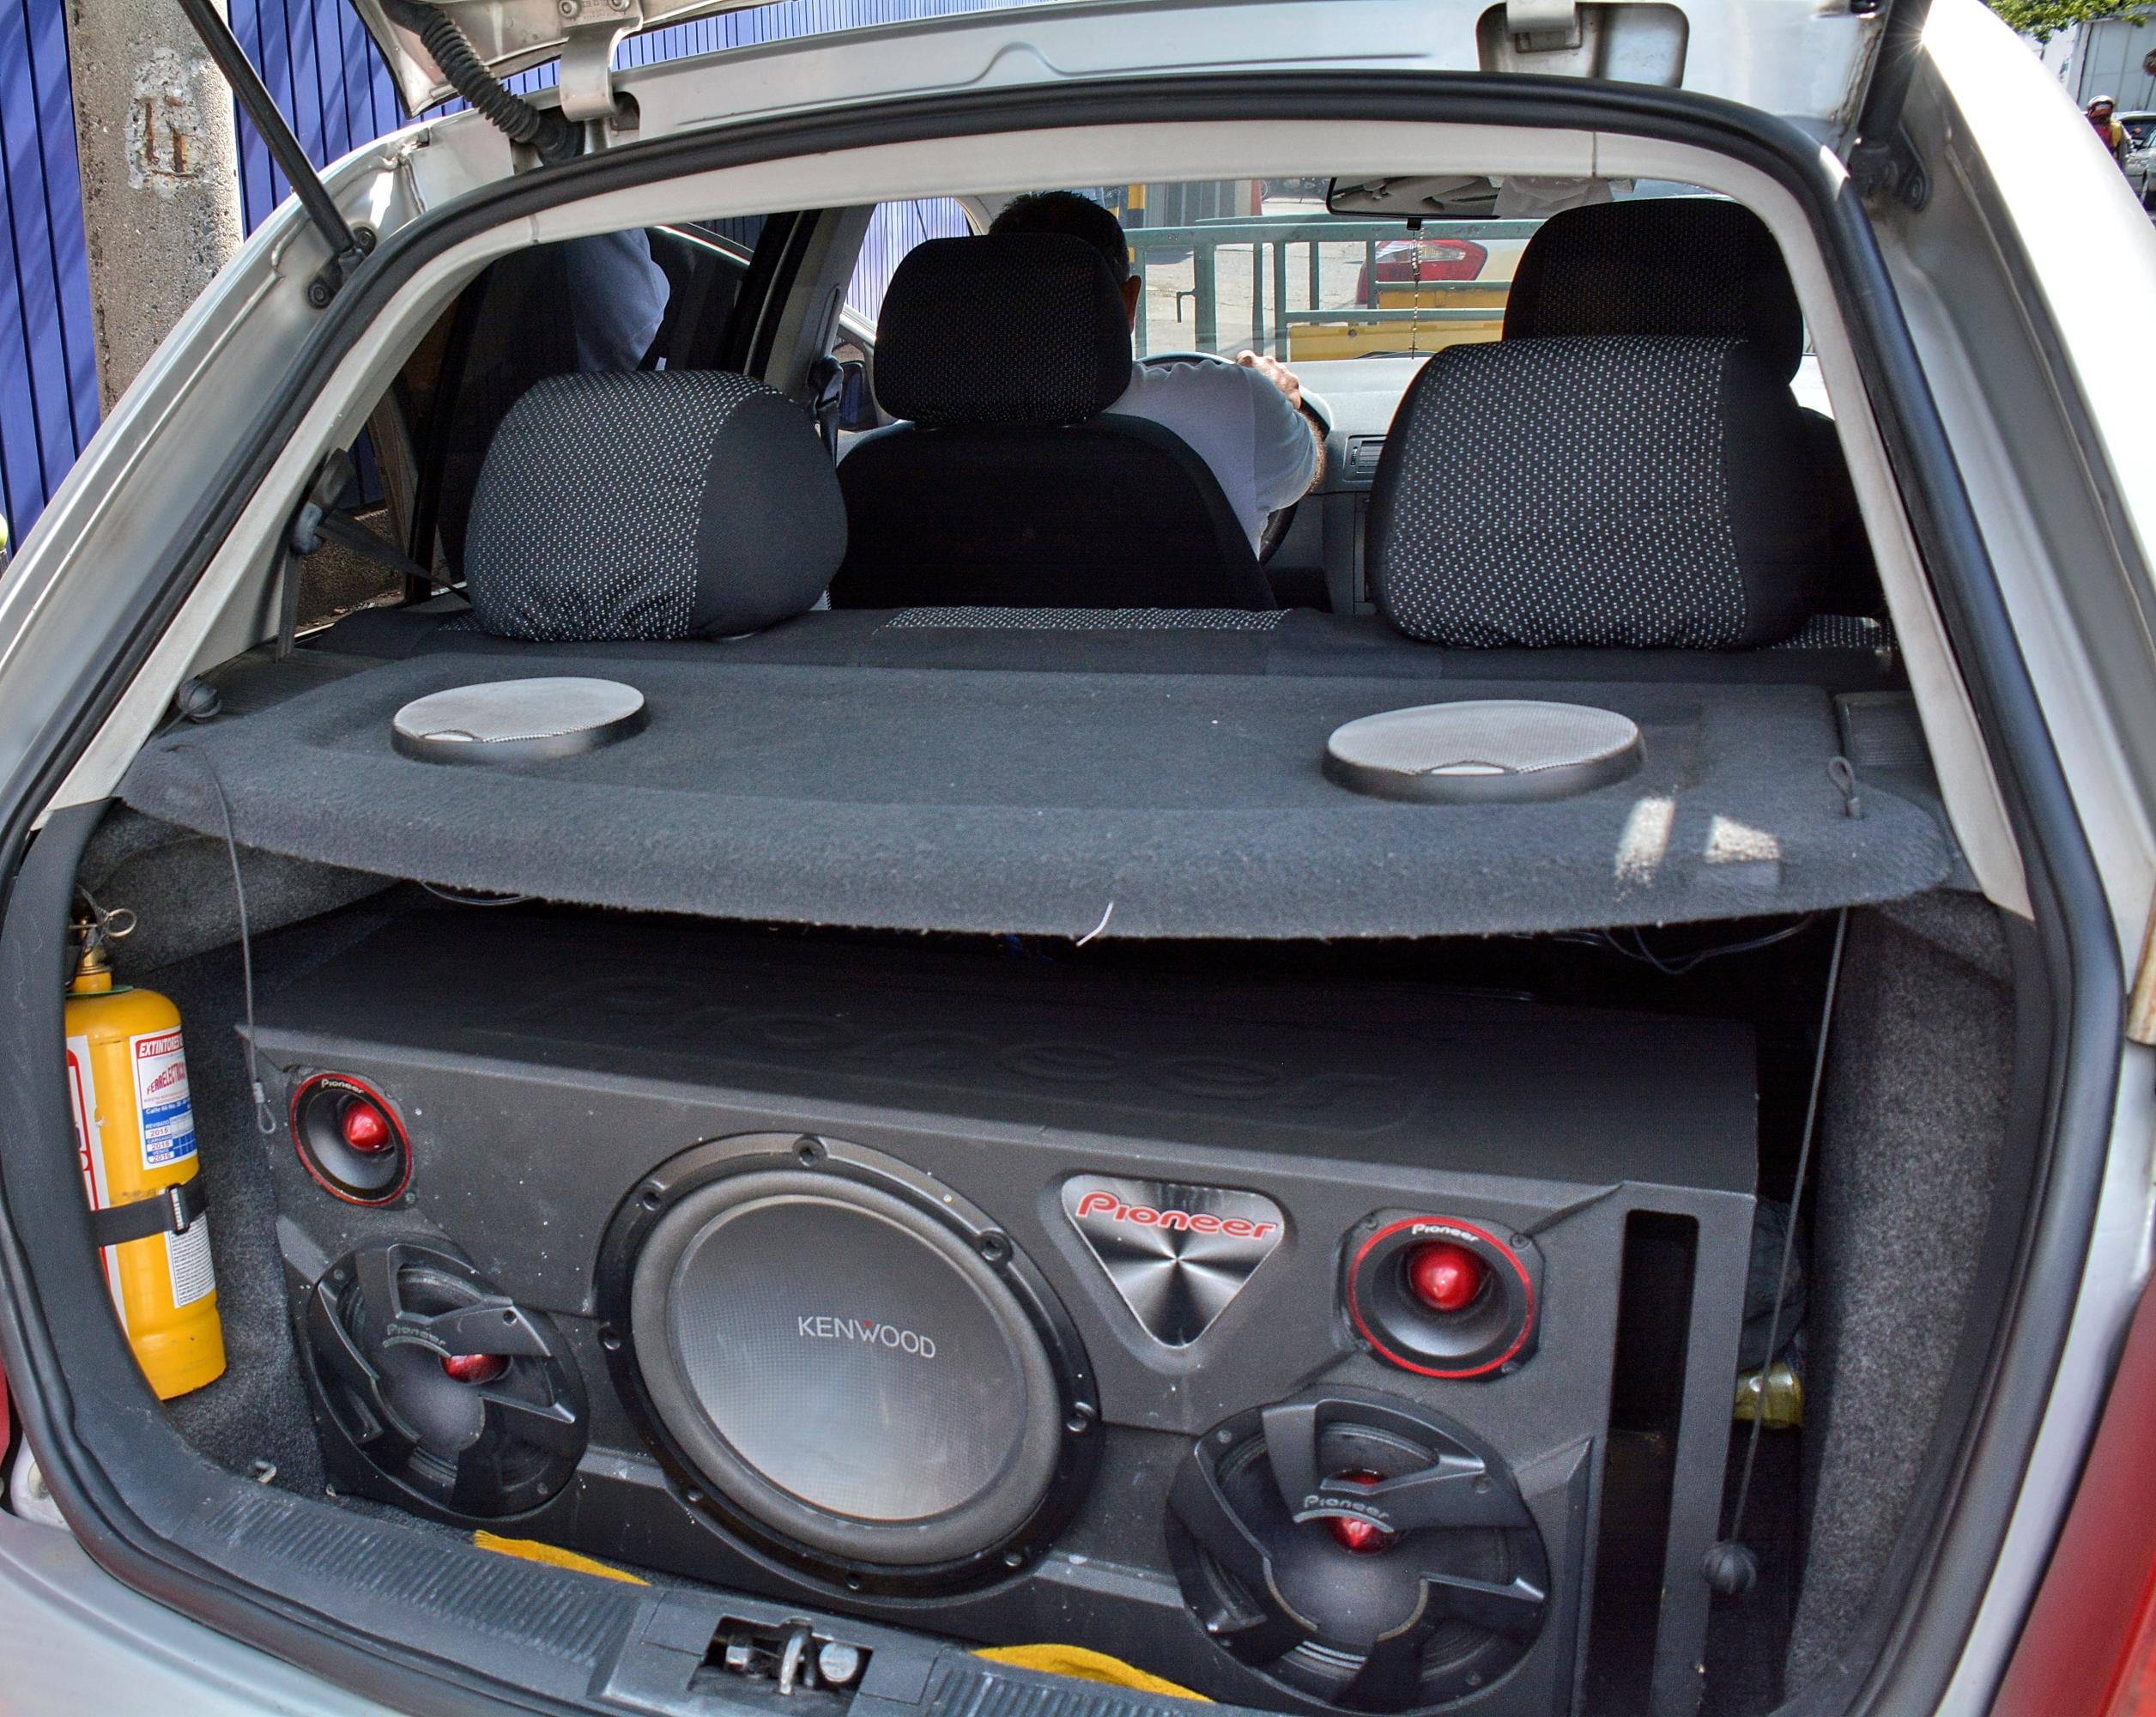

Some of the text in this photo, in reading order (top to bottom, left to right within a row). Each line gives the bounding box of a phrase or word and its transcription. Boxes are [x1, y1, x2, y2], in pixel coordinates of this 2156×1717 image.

[321, 1078, 365, 1094] Pioneer
[150, 1127, 169, 1138] 2015
[1075, 1190, 1277, 1240] Pioneer
[1412, 1223, 1480, 1241] Pioneer
[386, 1323, 446, 1347] Pioneer
[797, 1315, 936, 1358] KENWOOD
[1304, 1495, 1390, 1519] Pioneer
